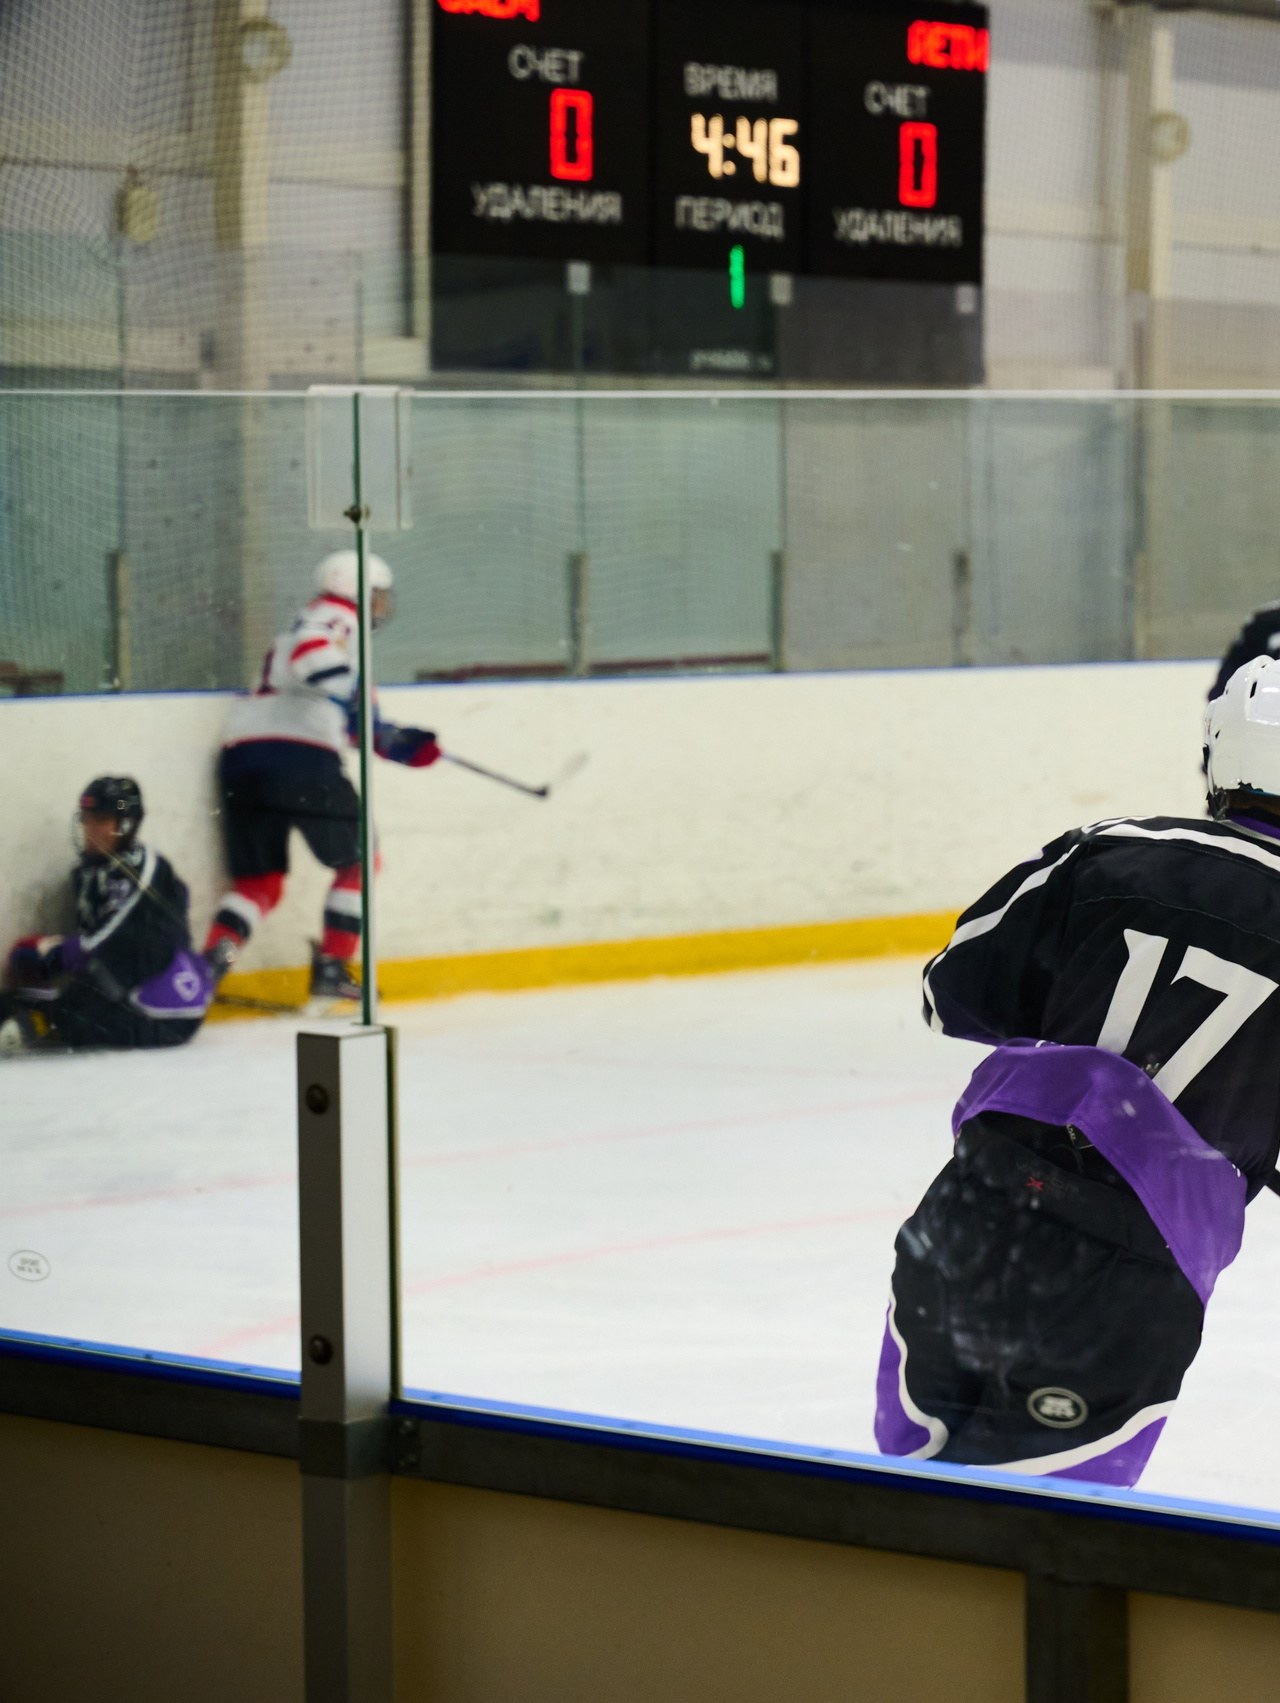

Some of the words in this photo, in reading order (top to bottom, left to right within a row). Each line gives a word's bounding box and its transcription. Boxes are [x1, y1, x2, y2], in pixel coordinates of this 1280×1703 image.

[684, 61, 778, 102] ВРЕМЯ
[550, 87, 593, 181] 0
[690, 112, 800, 188] 4:46
[899, 121, 937, 208] 0
[471, 181, 623, 224] УДАЛЕНИЯ
[674, 195, 785, 241] ПЕРИОД
[832, 206, 963, 247] УДАЛЕНИЯ
[729, 244, 745, 309] 1
[1096, 928, 1280, 1104] 17
